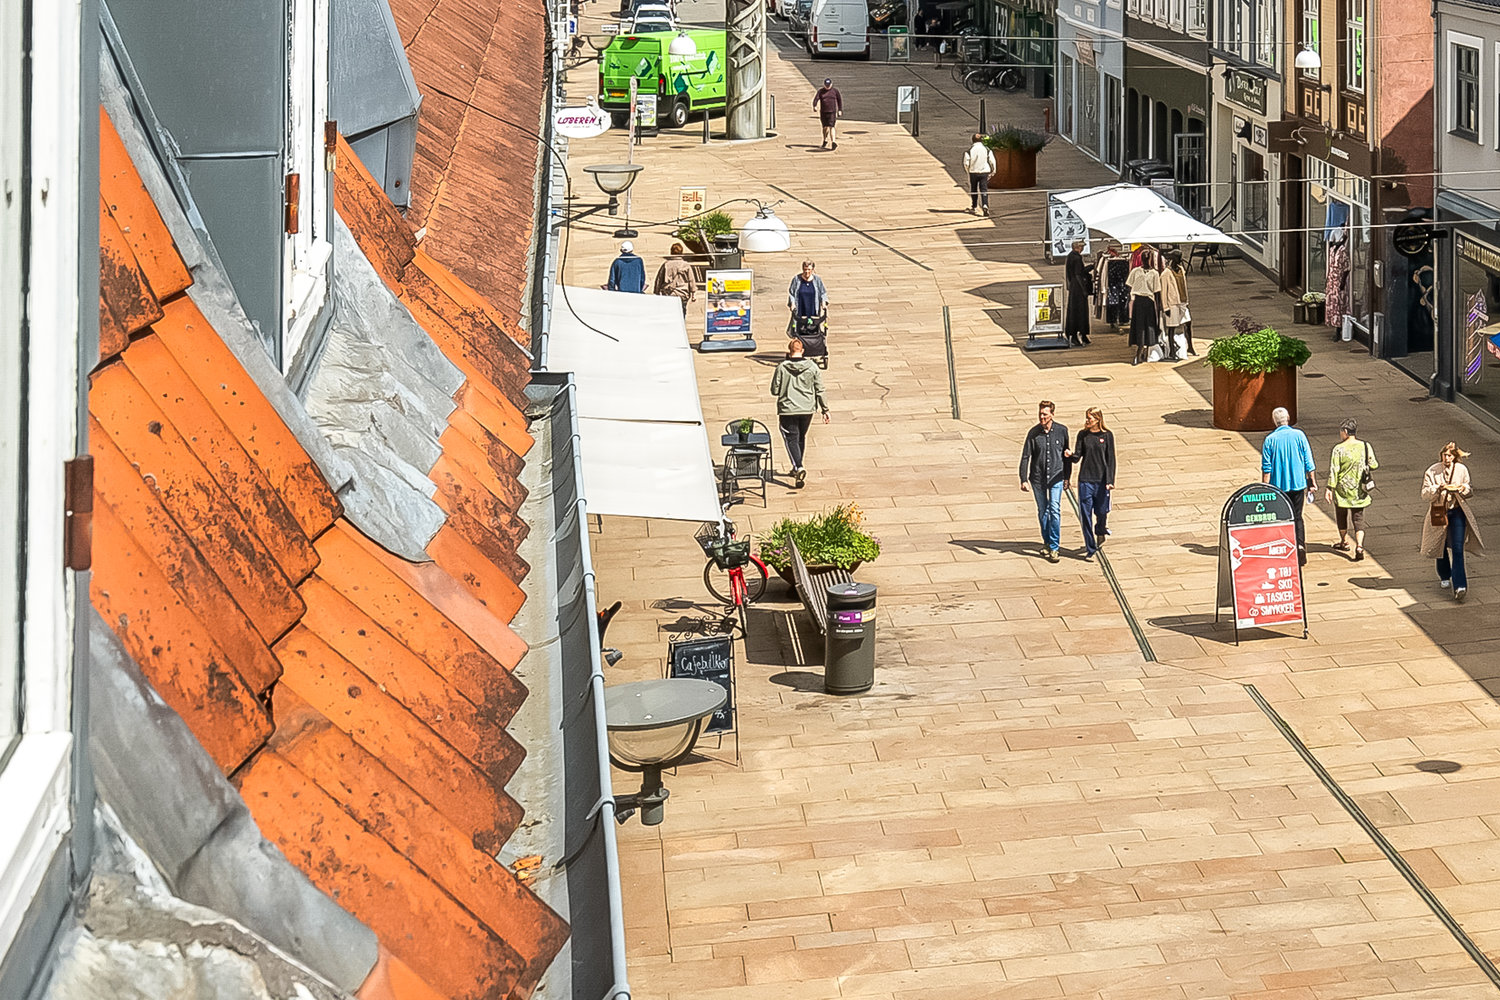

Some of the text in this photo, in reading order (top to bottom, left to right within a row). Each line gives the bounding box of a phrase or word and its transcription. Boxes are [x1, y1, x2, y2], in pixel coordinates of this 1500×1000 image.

[557, 116, 597, 125] LØBEREN
[1242, 492, 1277, 503] KVALITETS
[1245, 512, 1277, 523] GENBRUG
[1278, 566, 1292, 578] TØJ
[1277, 579, 1293, 590] SKO
[1265, 590, 1294, 603] TASKER
[1260, 603, 1295, 616] SMYKKER
